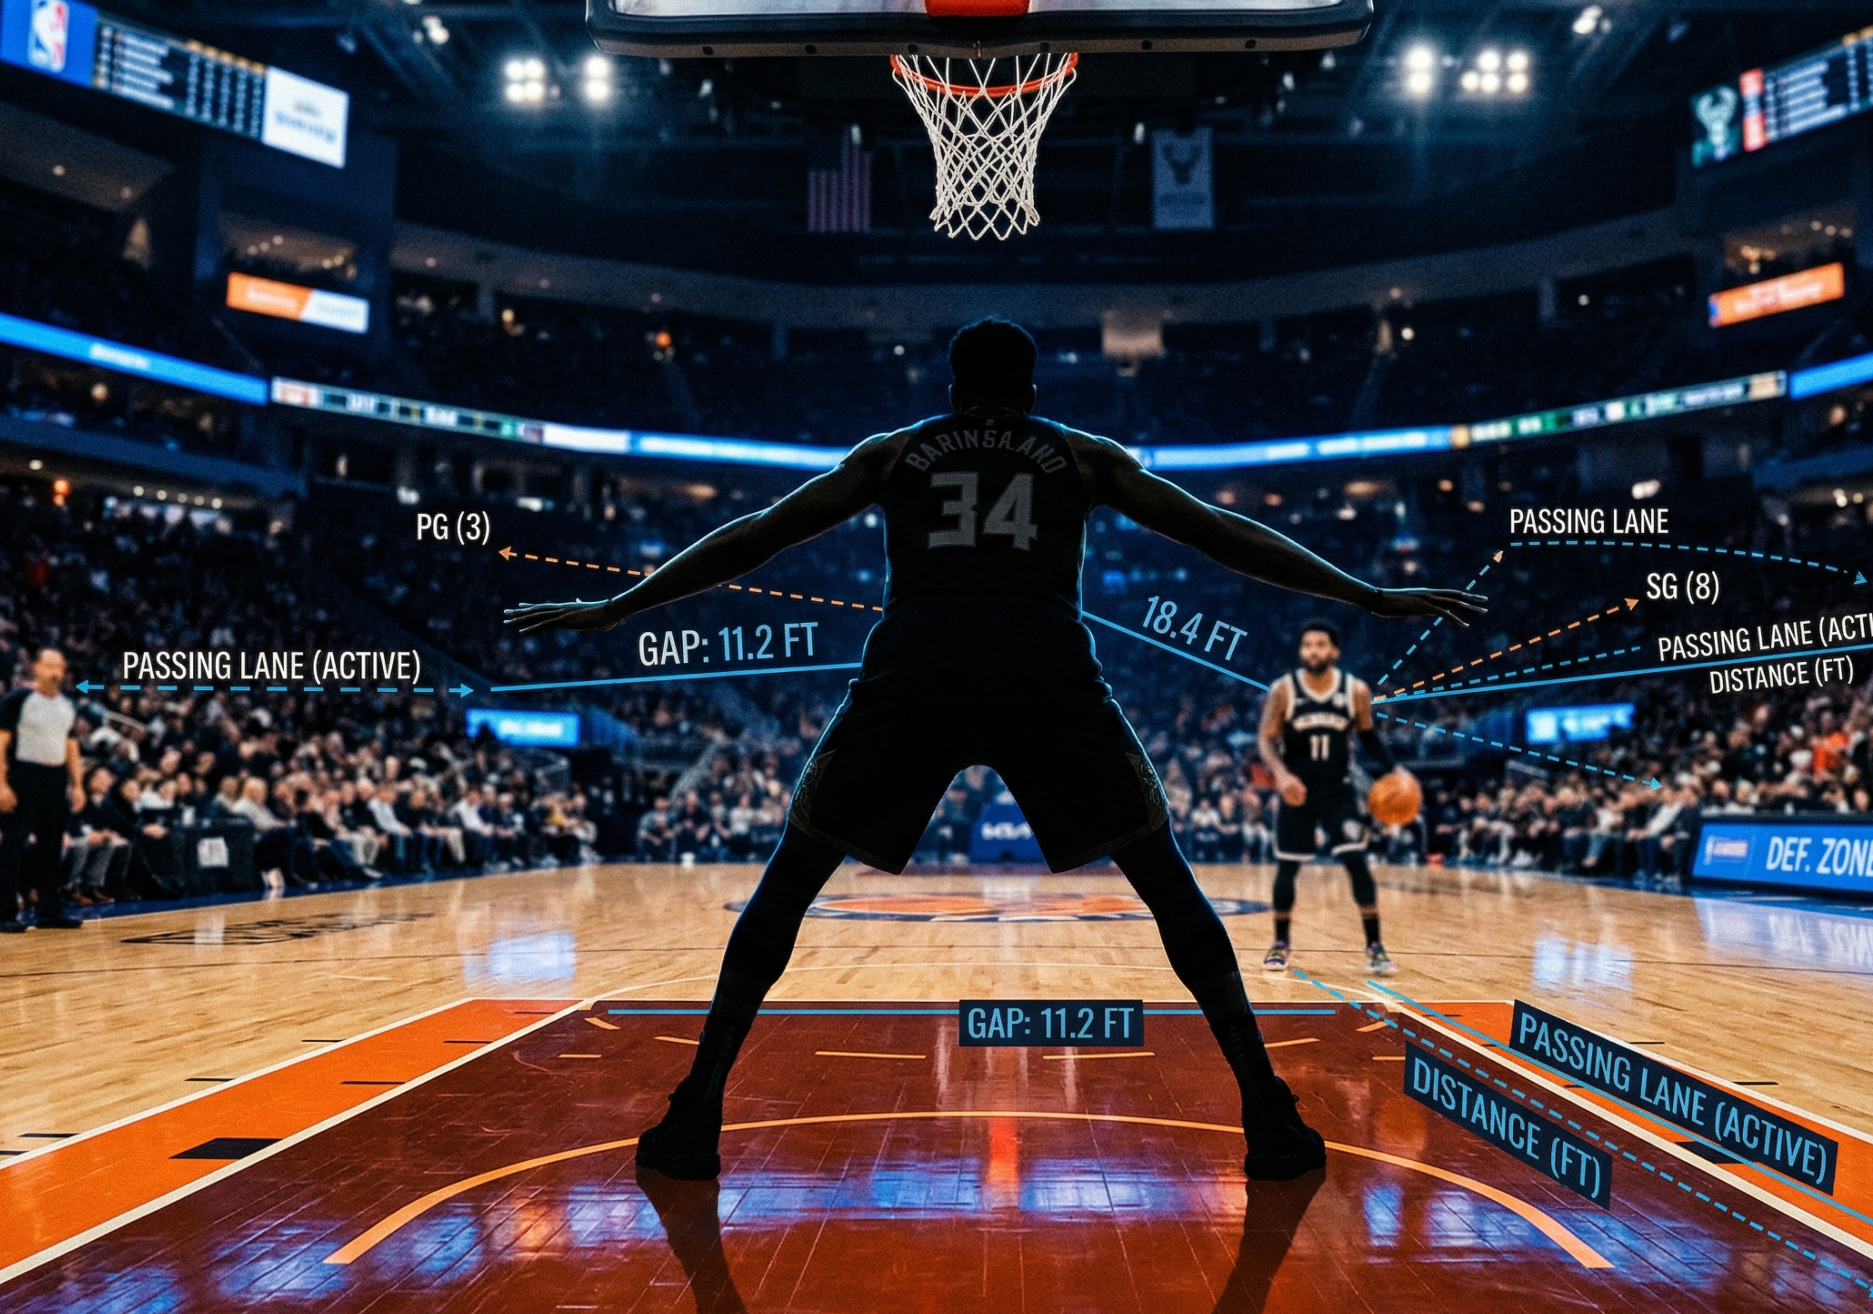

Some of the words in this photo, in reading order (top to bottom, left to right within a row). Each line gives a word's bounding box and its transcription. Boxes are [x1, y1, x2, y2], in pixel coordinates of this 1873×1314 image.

[928, 471, 1038, 551] 34
[1309, 734, 1331, 761] 11
[1766, 836, 1812, 873] DEF.
